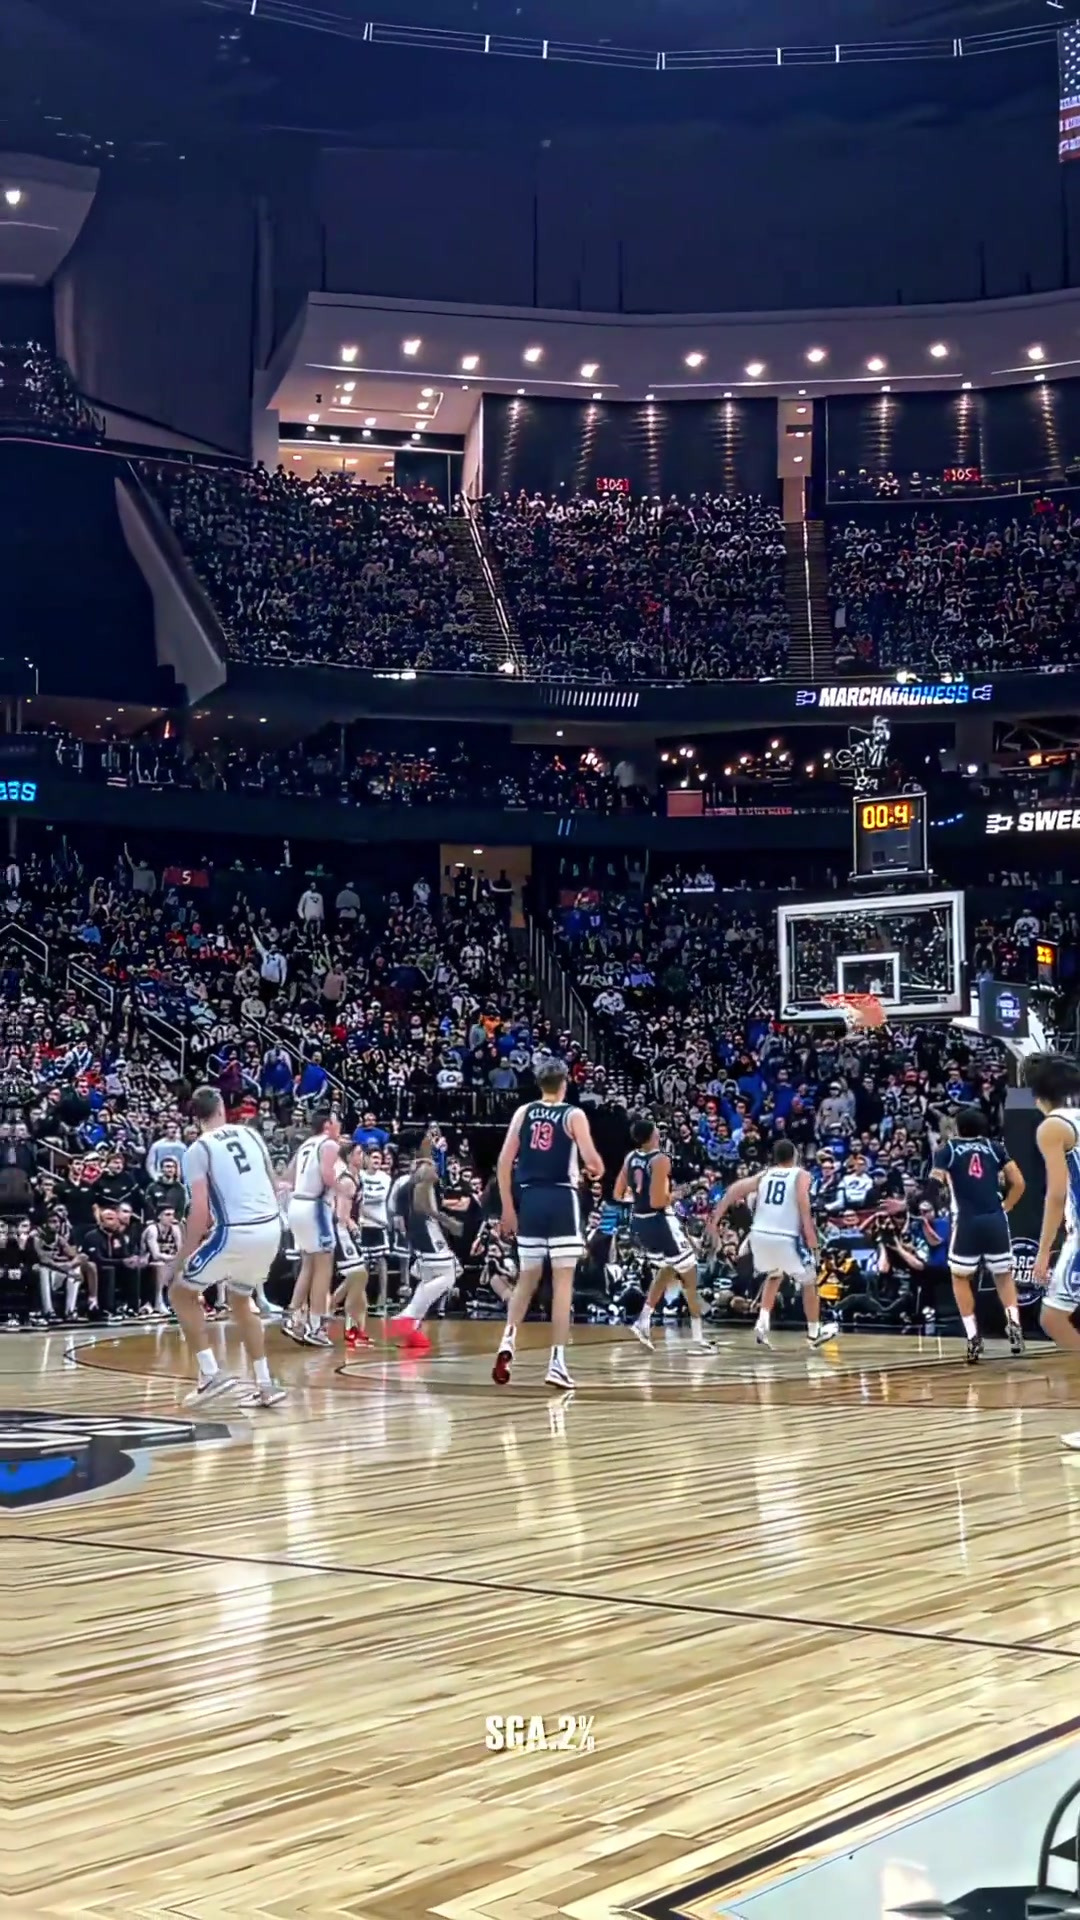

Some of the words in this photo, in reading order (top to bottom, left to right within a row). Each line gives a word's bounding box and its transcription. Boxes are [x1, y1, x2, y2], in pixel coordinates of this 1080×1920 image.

[530, 1120, 553, 1151] 13
[226, 1141, 252, 1175] 2
[301, 1150, 311, 1174] 7
[968, 1152, 983, 1179] 4
[764, 1179, 786, 1206] 18
